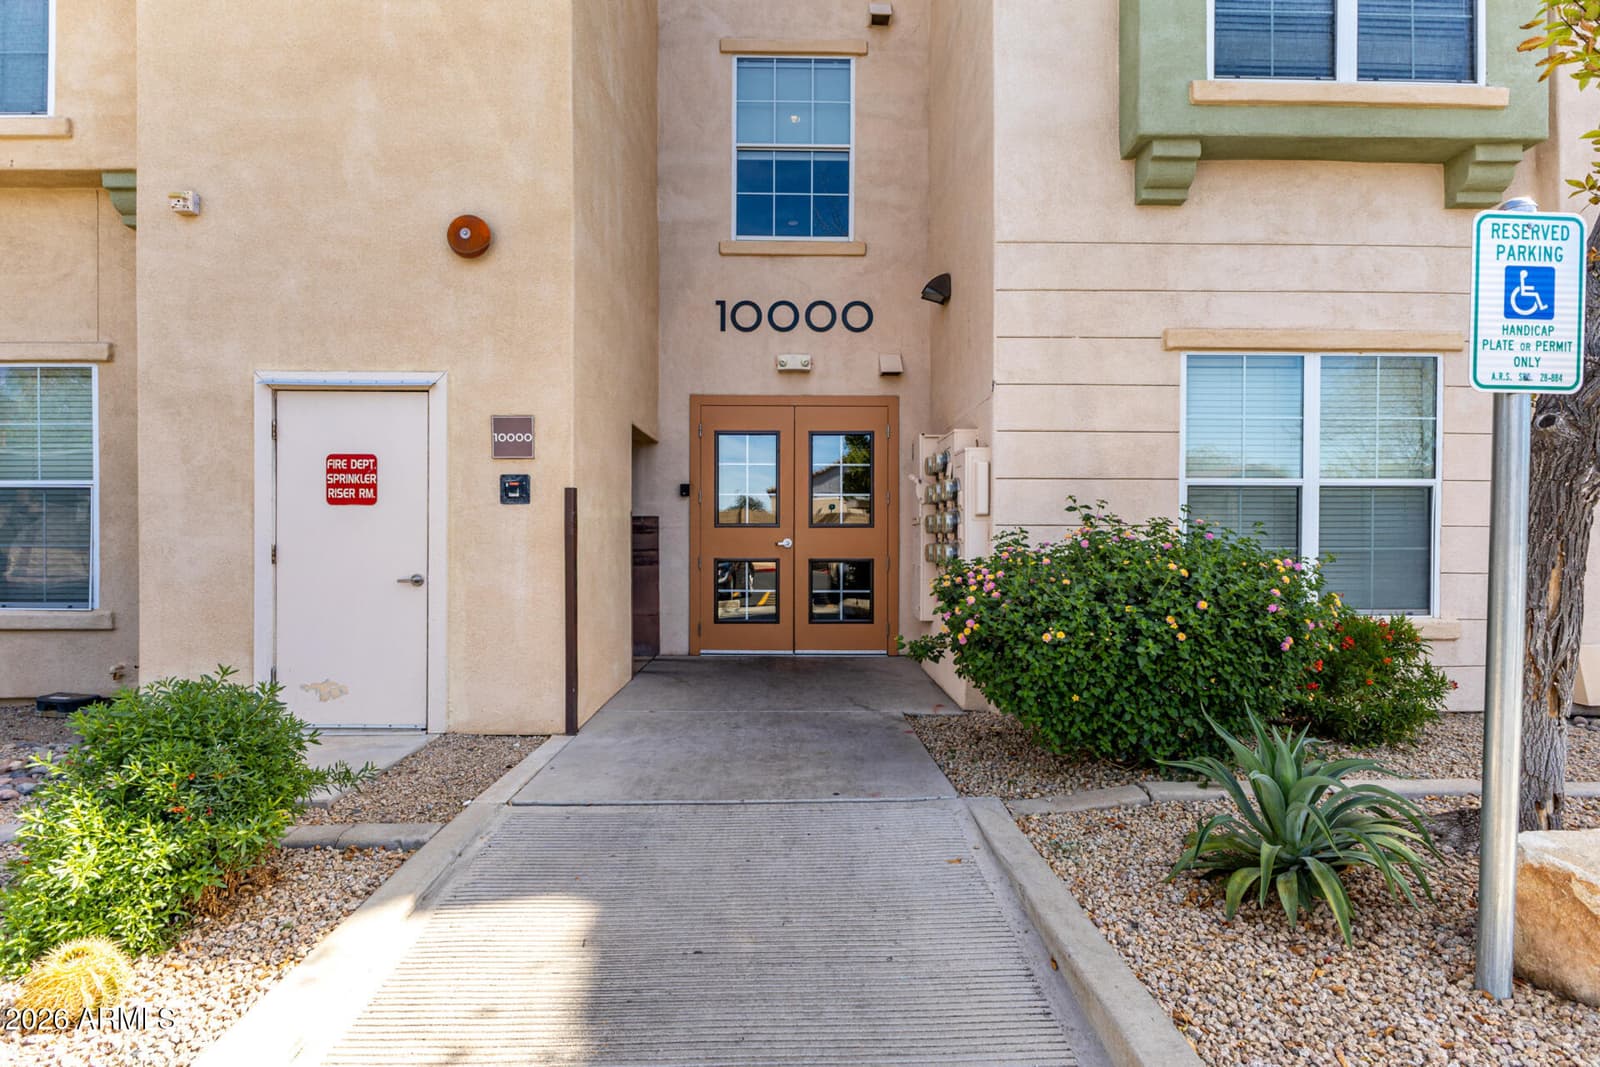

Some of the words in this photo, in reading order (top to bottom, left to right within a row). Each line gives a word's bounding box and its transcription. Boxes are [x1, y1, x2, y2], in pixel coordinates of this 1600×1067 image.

[1491, 223, 1570, 241] RESERVED
[1496, 245, 1564, 262] PARKING
[715, 300, 874, 333] 10000
[1502, 325, 1555, 337] HANDICAP
[1482, 339, 1514, 351] PLATE
[1520, 342, 1531, 351] OR
[1535, 341, 1572, 353] PERMIT
[1513, 356, 1541, 368] ONLY
[1491, 372, 1512, 381] A.R.S.
[1539, 373, 1563, 382] 28-884
[493, 433, 533, 442] 10000
[327, 459, 347, 469] FIRE
[350, 459, 376, 469] DEPT.
[327, 473, 377, 484] SPRINKLER
[328, 488, 355, 498] RISER
[358, 488, 376, 498] RM.
